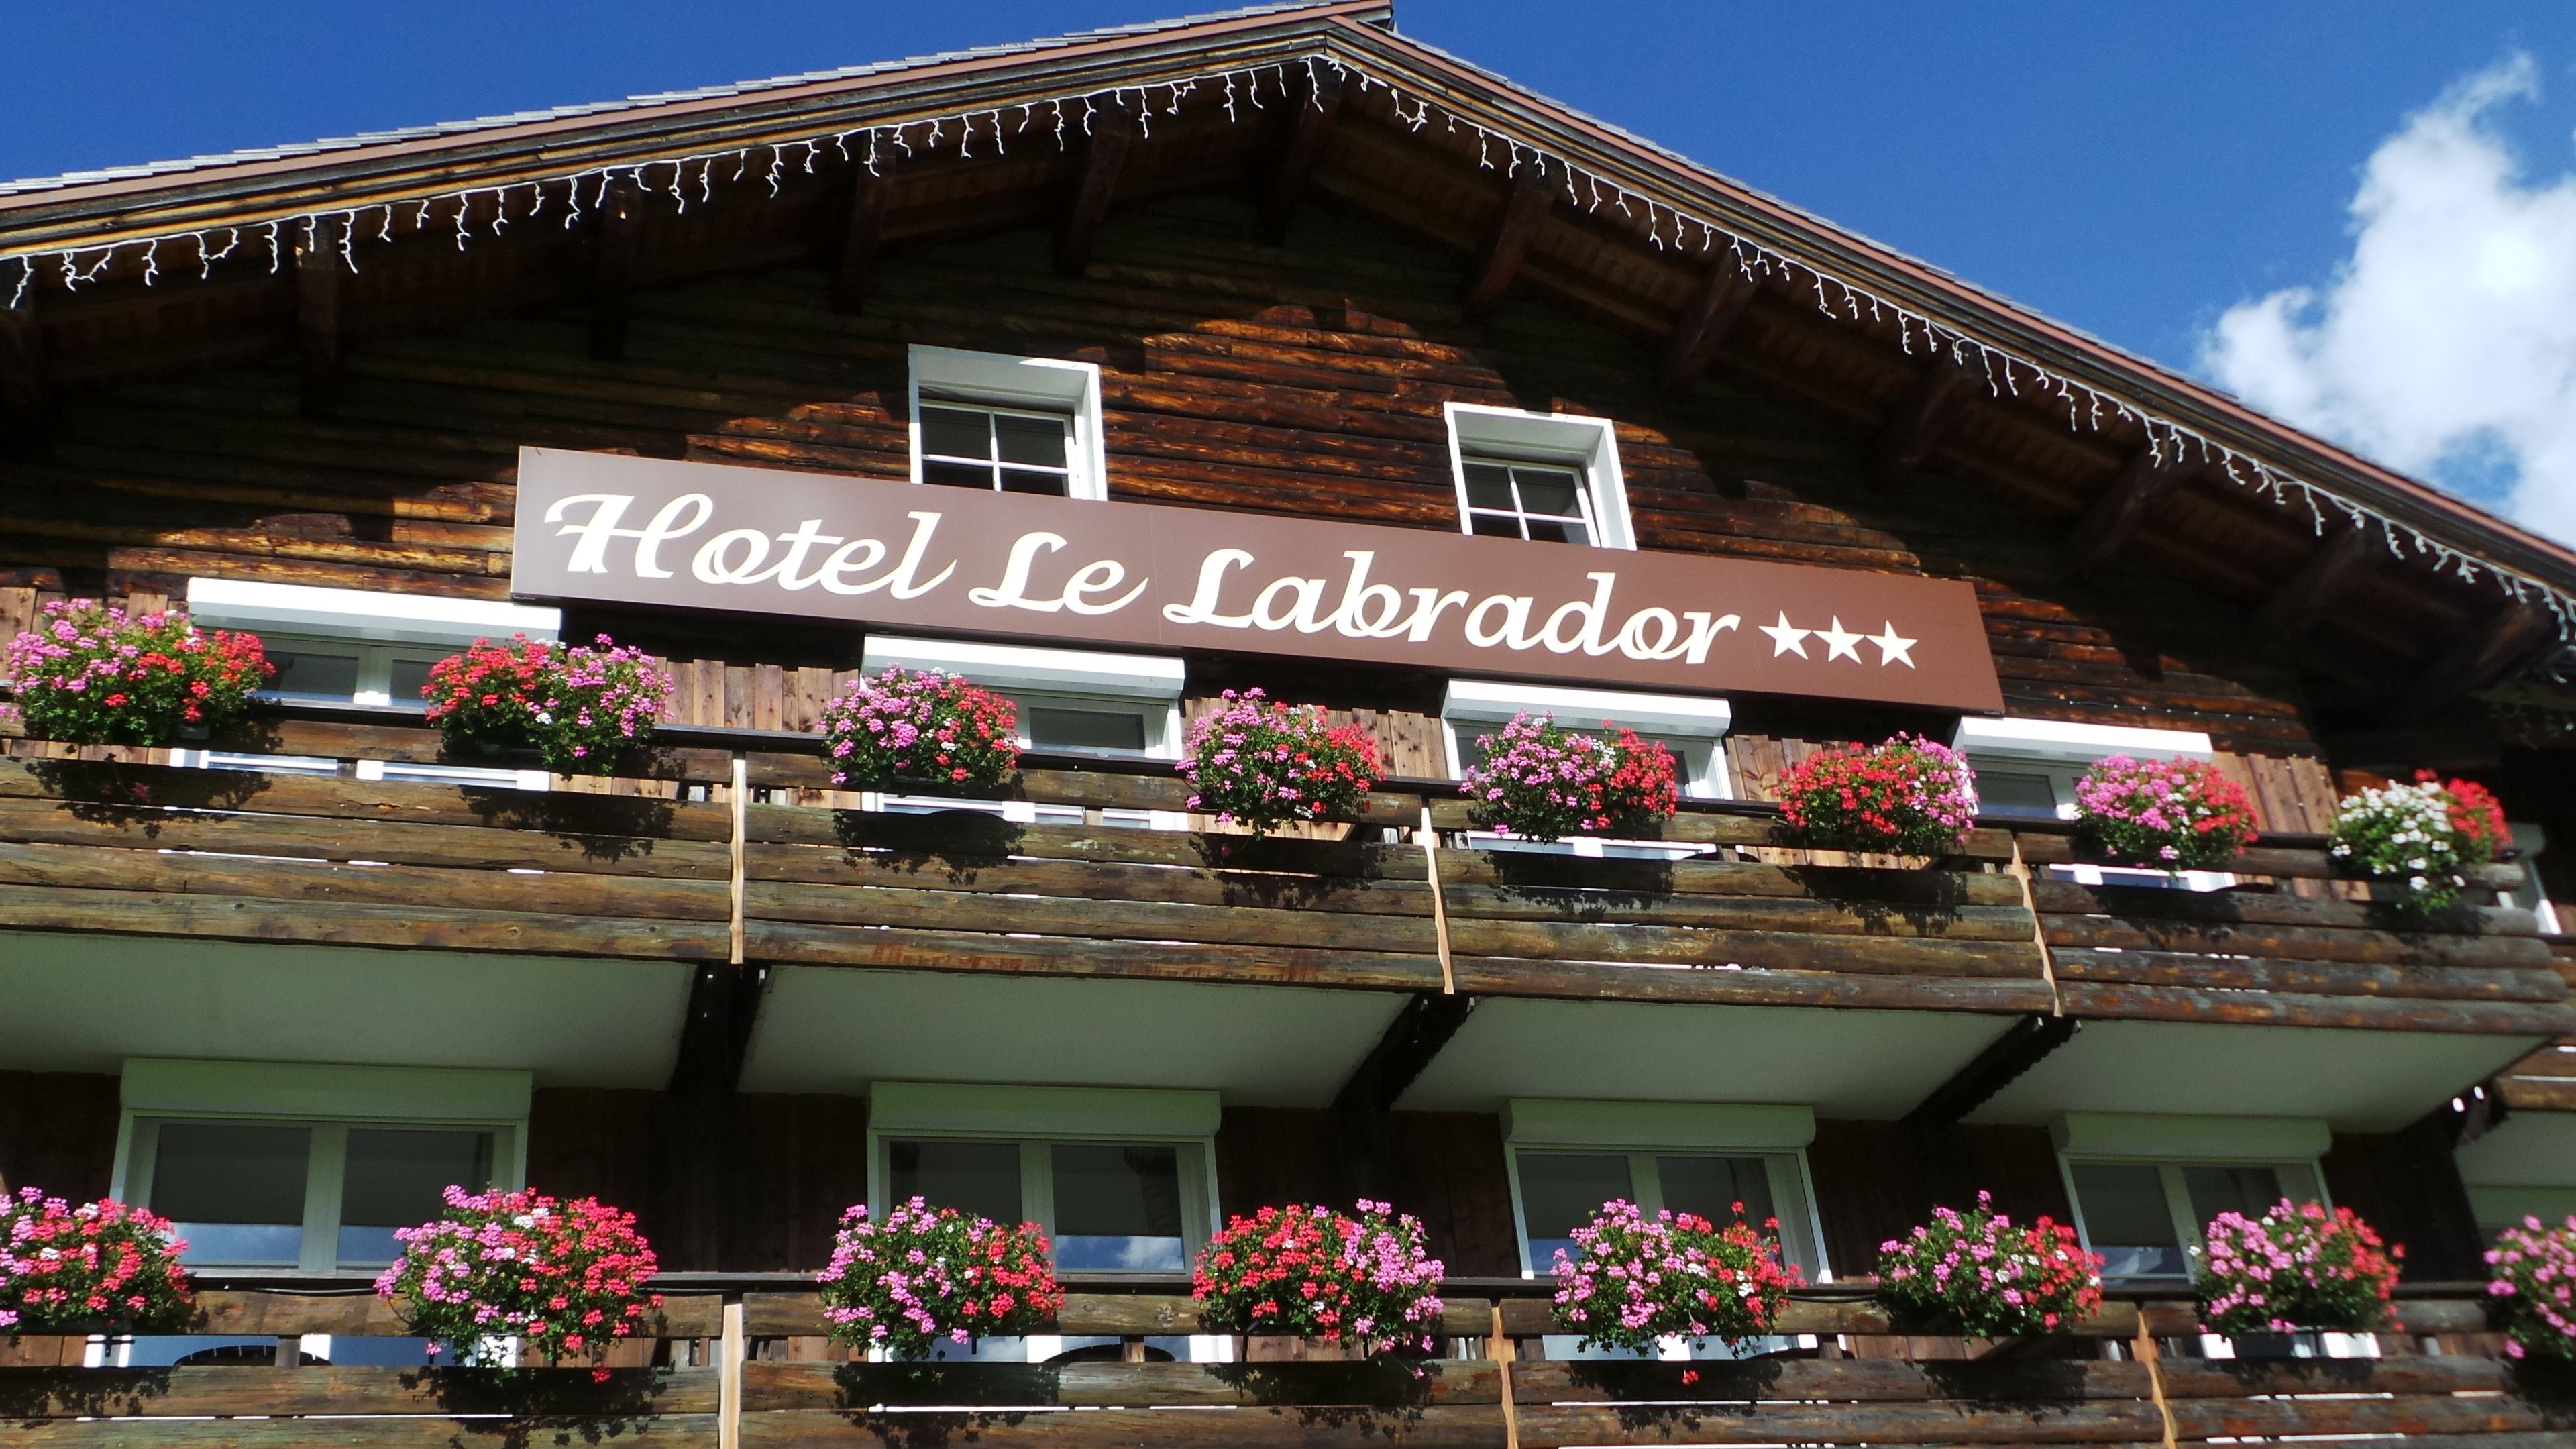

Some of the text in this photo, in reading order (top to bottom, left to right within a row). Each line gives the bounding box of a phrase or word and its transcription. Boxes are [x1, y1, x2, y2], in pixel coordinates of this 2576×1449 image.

[544, 493, 1740, 664] Hotel Le Labrador
